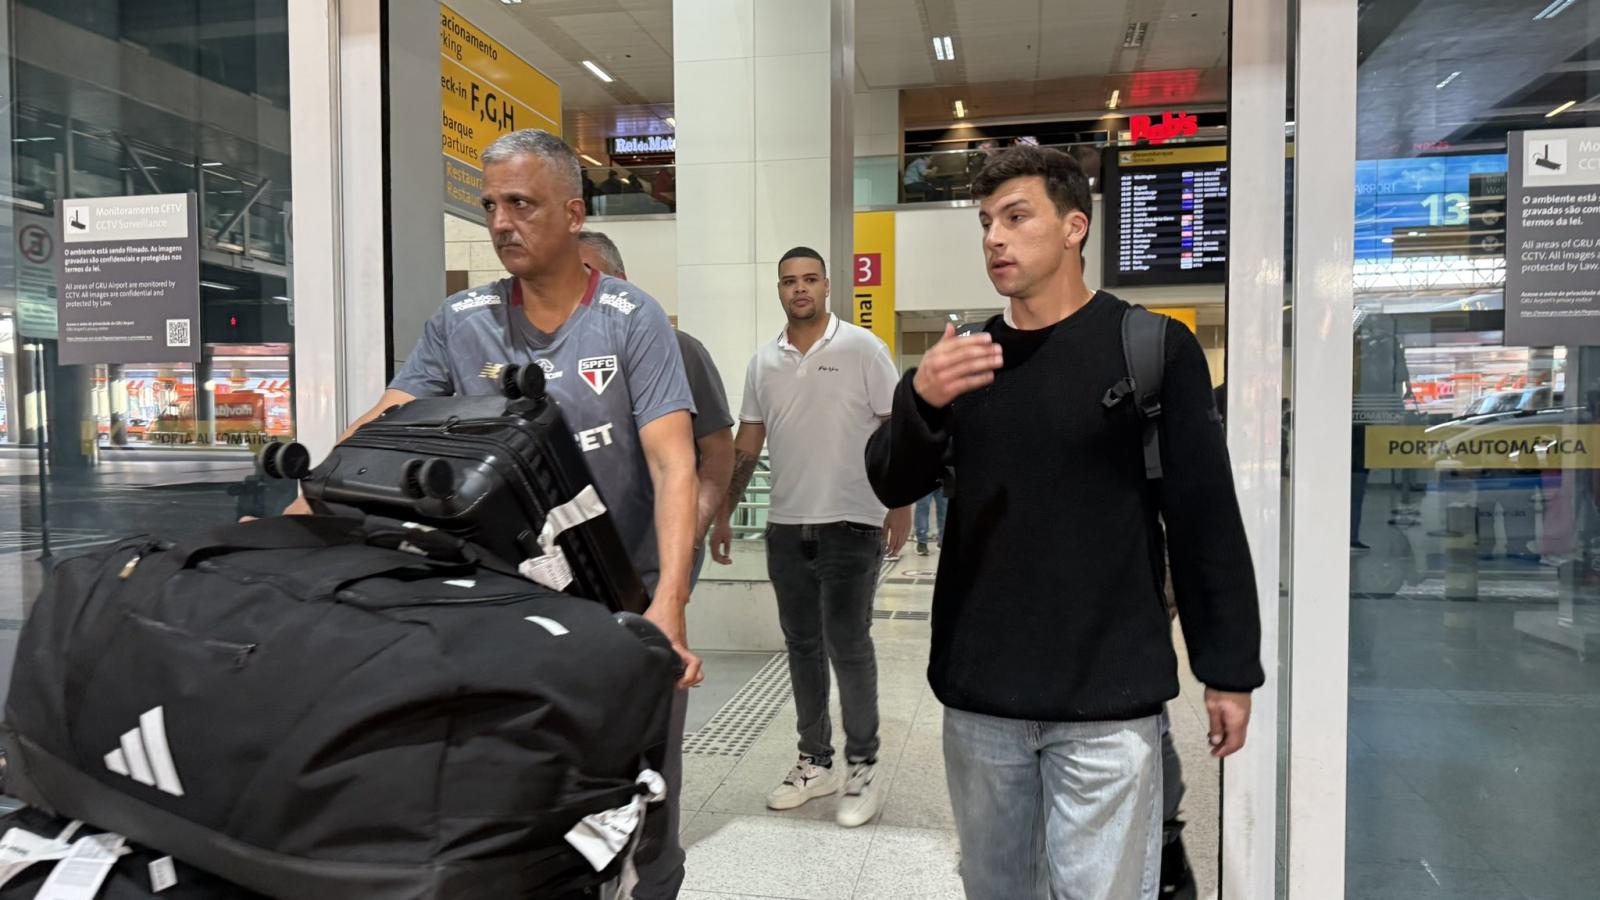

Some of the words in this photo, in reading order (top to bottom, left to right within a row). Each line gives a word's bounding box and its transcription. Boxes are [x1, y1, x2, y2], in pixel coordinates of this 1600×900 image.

[440, 13, 498, 60] acionamento
[441, 30, 462, 61] king
[443, 110, 473, 139] barque
[442, 134, 478, 160] partures
[1522, 196, 1530, 204] O
[1532, 194, 1576, 204] ambiente
[1577, 193, 1596, 202] está
[96, 205, 159, 217] Monitoramento
[161, 204, 182, 213] CFTV
[1421, 193, 1469, 226] 13
[1522, 207, 1562, 218] gravadas
[1564, 206, 1580, 214] são
[96, 220, 118, 230] CCTV
[119, 218, 168, 230] Surveillance
[1522, 218, 1554, 227] termos
[1556, 217, 1568, 226] da
[1570, 216, 1584, 226] lei.
[1522, 240, 1534, 249] All
[1535, 241, 1560, 249] areas
[1562, 238, 1572, 248] of
[1572, 239, 1594, 248] GRU
[64, 248, 70, 256] O
[70, 248, 96, 256] ambiente
[97, 246, 108, 255] está
[158, 245, 182, 254] imagens
[1548, 251, 1560, 260] All
[1562, 250, 1596, 262] images
[64, 257, 88, 266] gravadas
[90, 256, 99, 264] são
[100, 255, 136, 264] confidenciais
[141, 254, 170, 263] protegidas
[858, 257, 872, 282] 3
[1521, 262, 1564, 274] protected
[1567, 262, 1578, 273] by
[88, 282, 95, 290] of
[108, 280, 128, 290] Airport
[138, 280, 168, 288] monitored
[168, 280, 176, 289] by
[90, 290, 109, 300] images
[120, 289, 152, 298] confidential
[65, 300, 92, 309] protected
[92, 299, 99, 308] by
[582, 360, 615, 370] SPFC
[574, 422, 613, 452] ET
[1388, 440, 1450, 455] PORTA
[1454, 436, 1587, 455] AUTOMÁTICA
